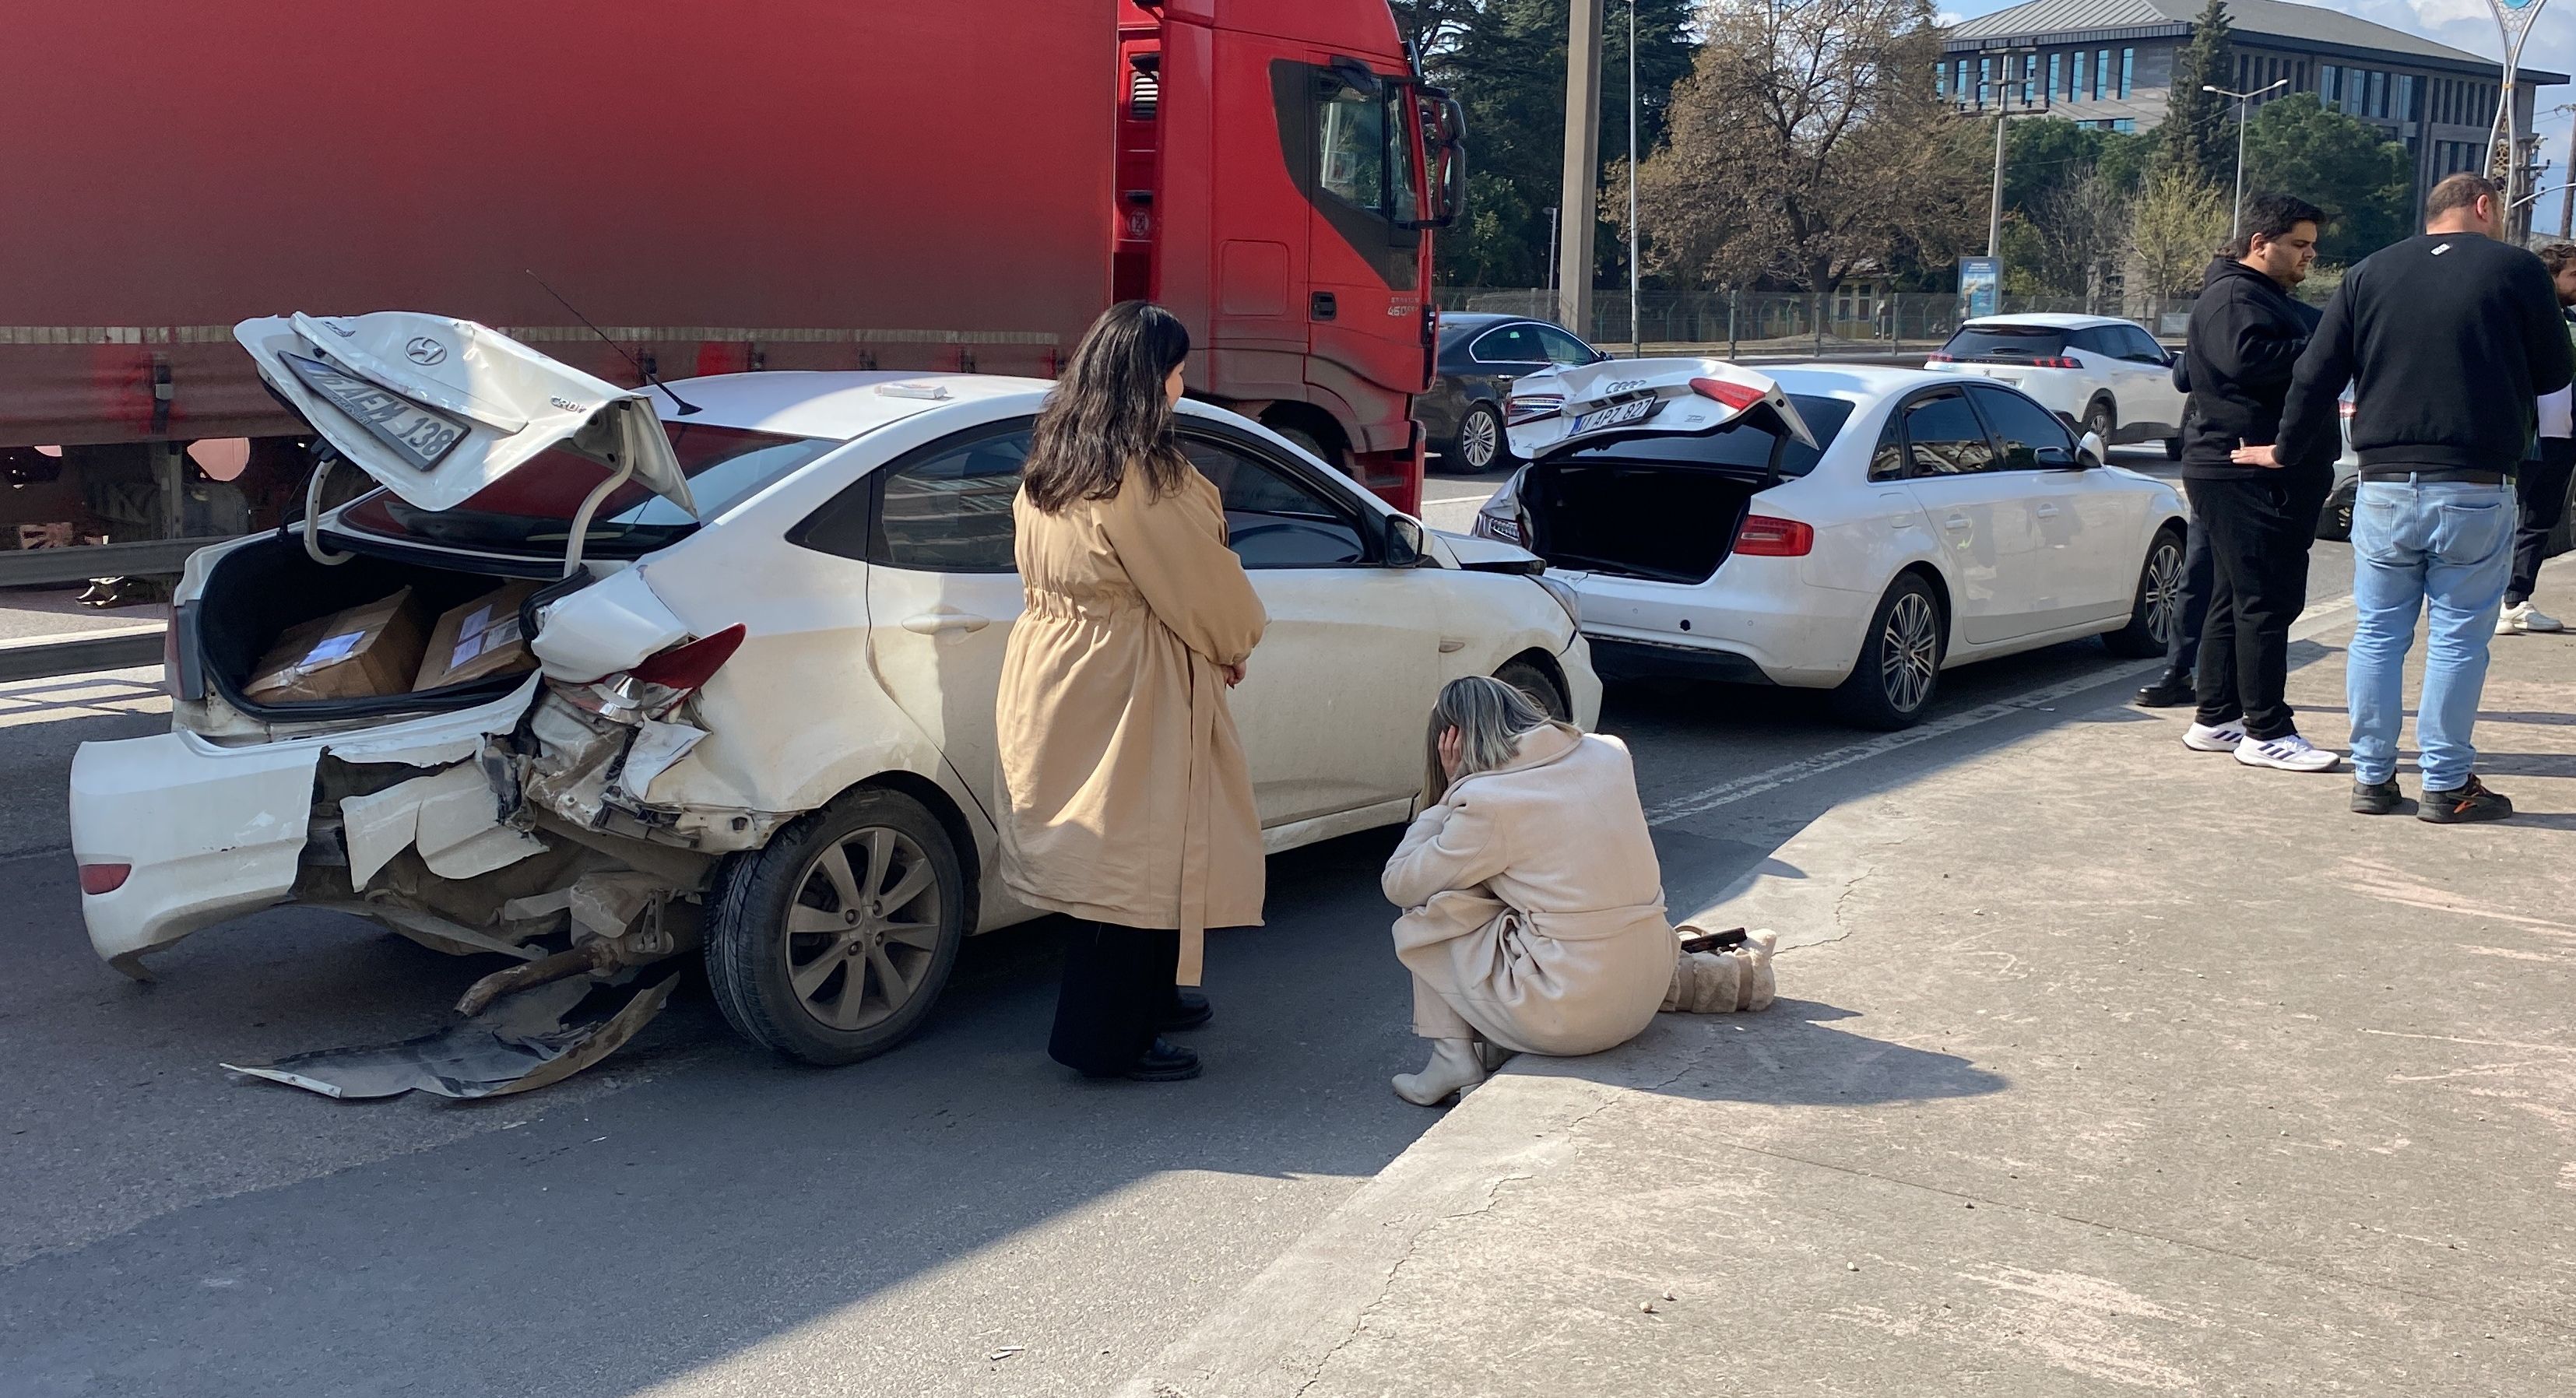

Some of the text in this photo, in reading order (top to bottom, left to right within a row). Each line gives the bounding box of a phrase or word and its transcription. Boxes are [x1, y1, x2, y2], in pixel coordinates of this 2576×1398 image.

[332, 387, 410, 427] AEM
[396, 417, 455, 456] 138
[1592, 406, 1622, 428] APZ
[1622, 398, 1652, 420] 827
